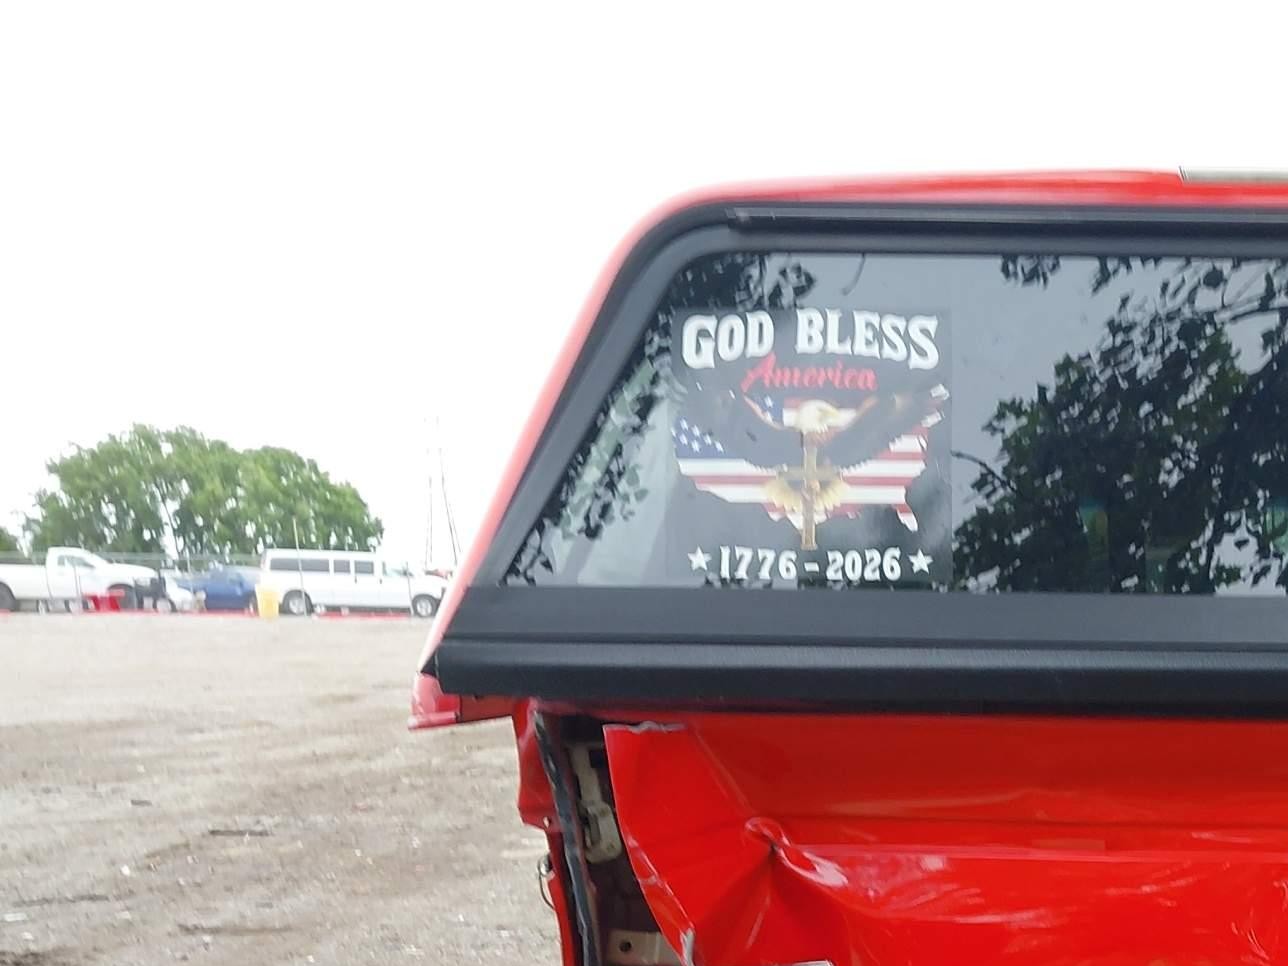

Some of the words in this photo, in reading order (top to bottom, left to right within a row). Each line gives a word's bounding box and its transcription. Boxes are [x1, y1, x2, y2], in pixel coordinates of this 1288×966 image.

[682, 311, 775, 369] GOD
[795, 307, 940, 370] BLESS
[740, 352, 878, 392] America
